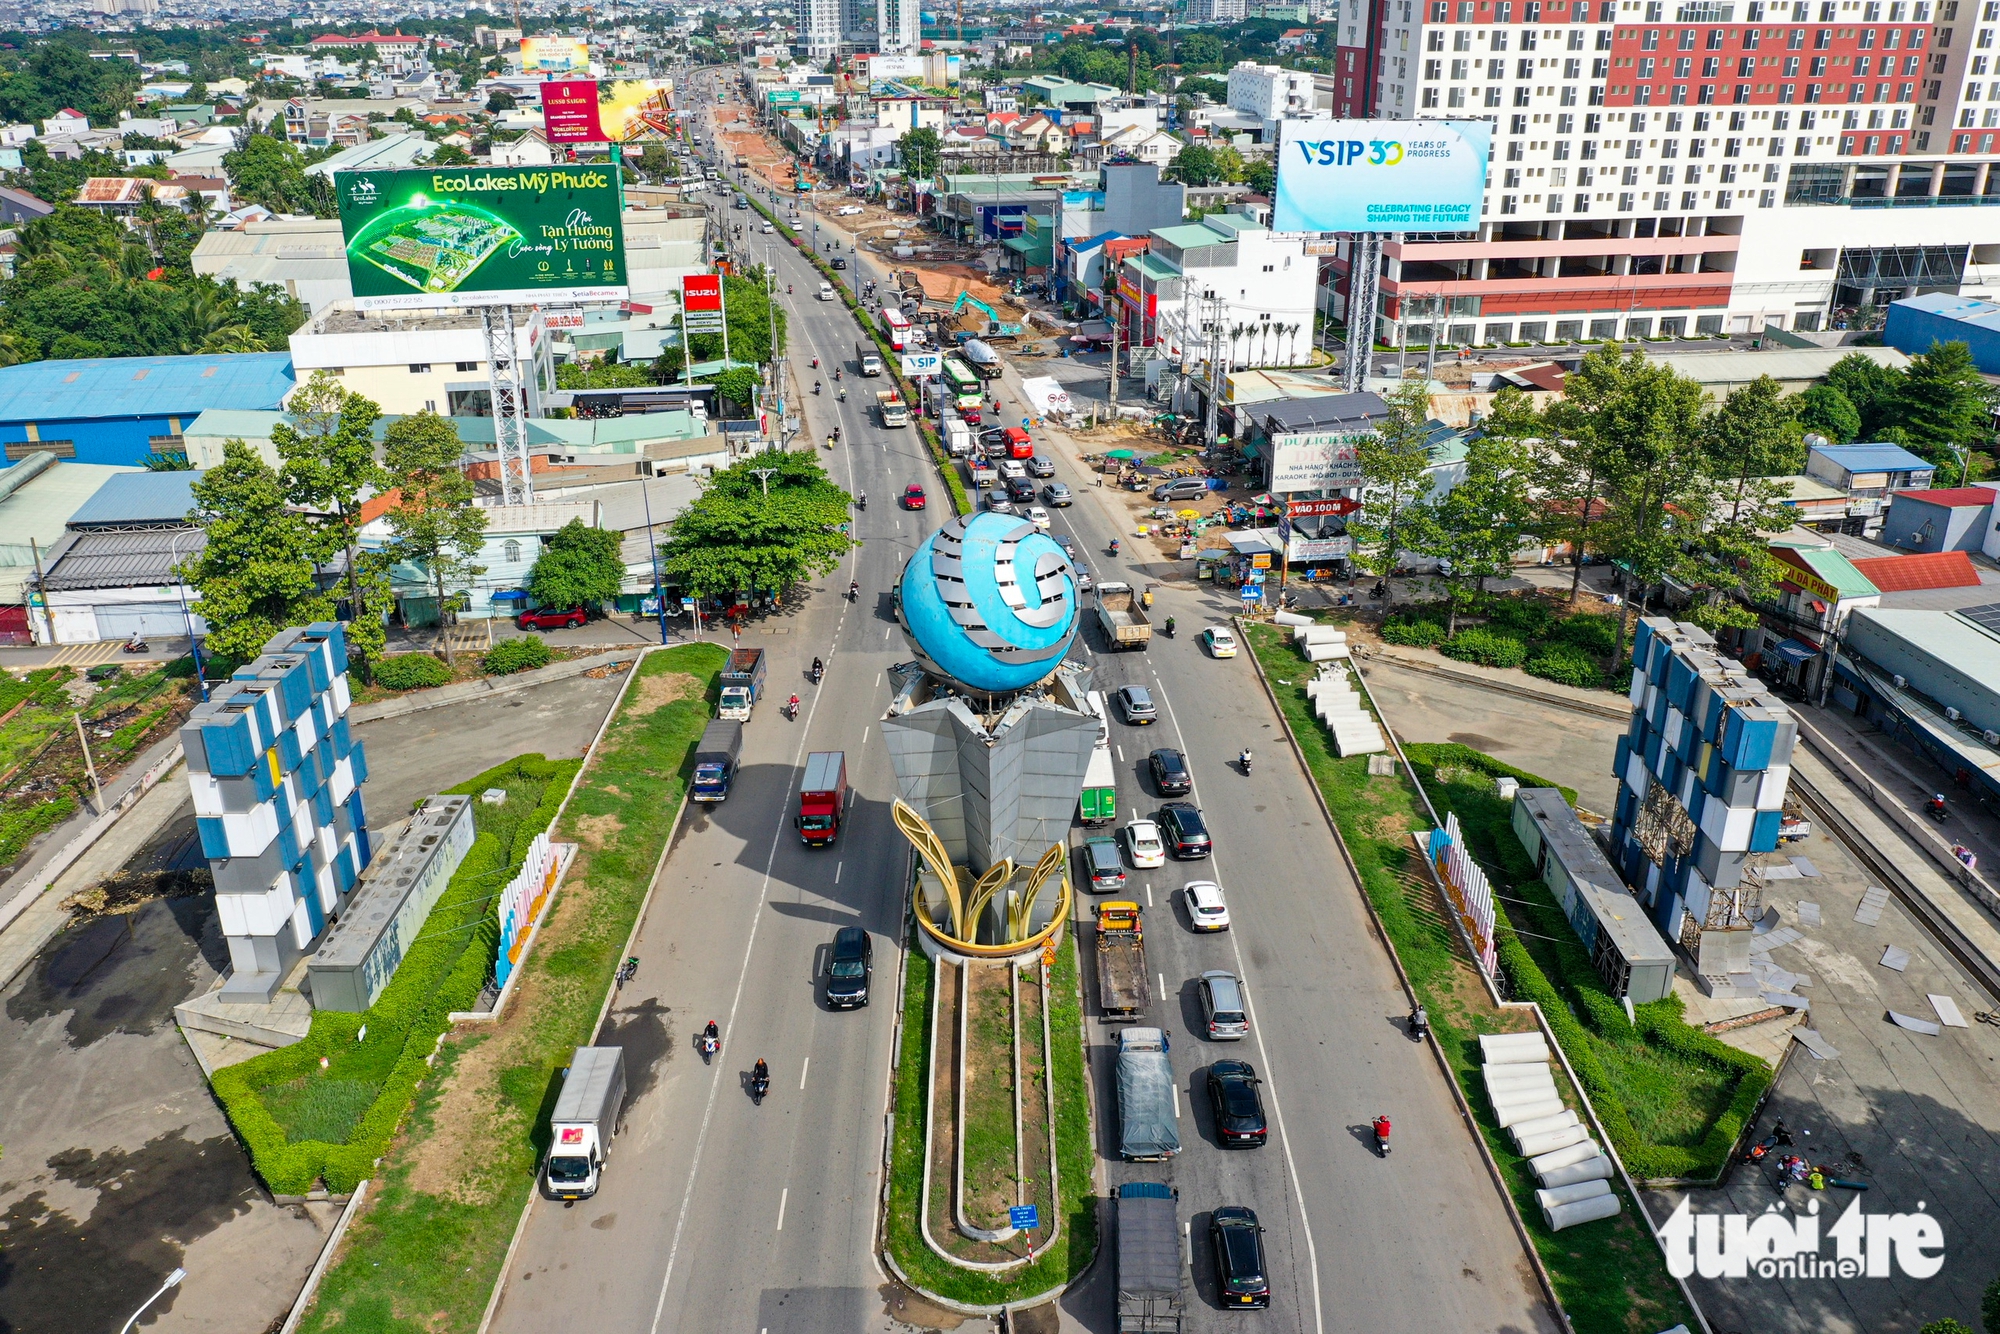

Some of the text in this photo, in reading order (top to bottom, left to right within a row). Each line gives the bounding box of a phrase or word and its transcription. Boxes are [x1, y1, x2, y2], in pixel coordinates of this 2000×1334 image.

[1293, 140, 1404, 166] VSIP 30
[432, 170, 608, 194] EcoLakes Mỹ Phước
[1367, 204, 1471, 212] CELEBRATING LEGACY
[565, 208, 593, 229] Nơi
[1367, 214, 1469, 222] SHAPING THE FUTURE
[539, 223, 613, 239] Tận Hưởng
[555, 238, 569, 252] Lý
[569, 236, 613, 251] Tưởng
[907, 357, 936, 367] VSIP
[1284, 437, 1302, 446] DU
[1295, 502, 1312, 513] VÀO
